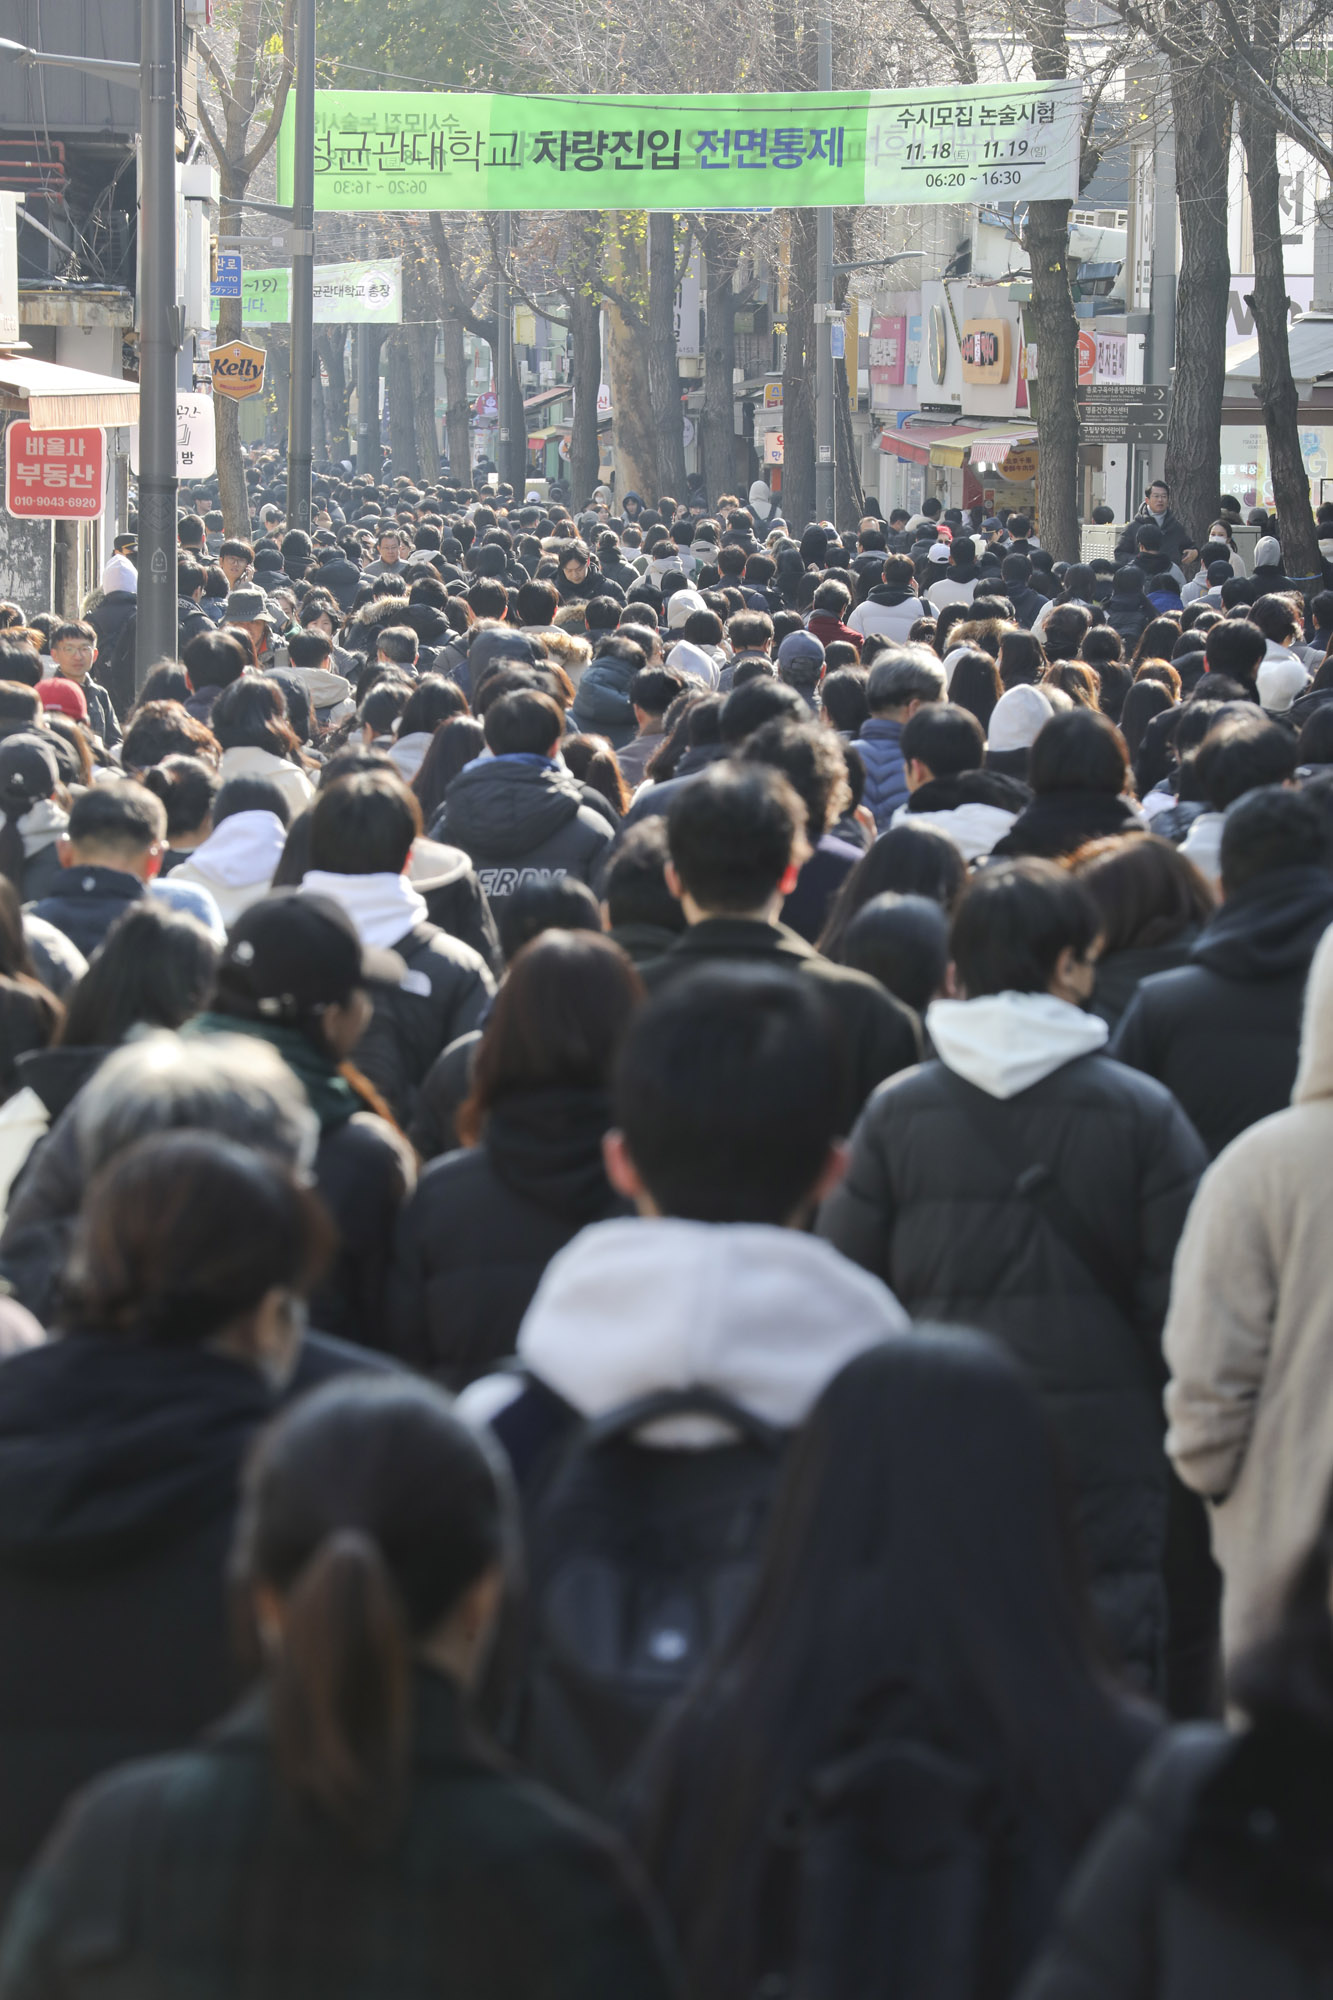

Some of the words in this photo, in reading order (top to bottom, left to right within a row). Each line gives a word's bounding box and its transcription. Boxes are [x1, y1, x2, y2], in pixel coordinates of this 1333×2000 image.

[897, 106, 973, 130] 수시모집
[978, 102, 1055, 126] 논술시험
[532, 129, 682, 172] 차량진입
[694, 125, 845, 169] 전면통제
[925, 173, 966, 188] 06:20
[982, 171, 1022, 186] 16:30
[368, 283, 391, 298] 총장
[213, 358, 265, 382] Kelly
[25, 436, 86, 457] 바울사
[16, 462, 95, 489] 부동산
